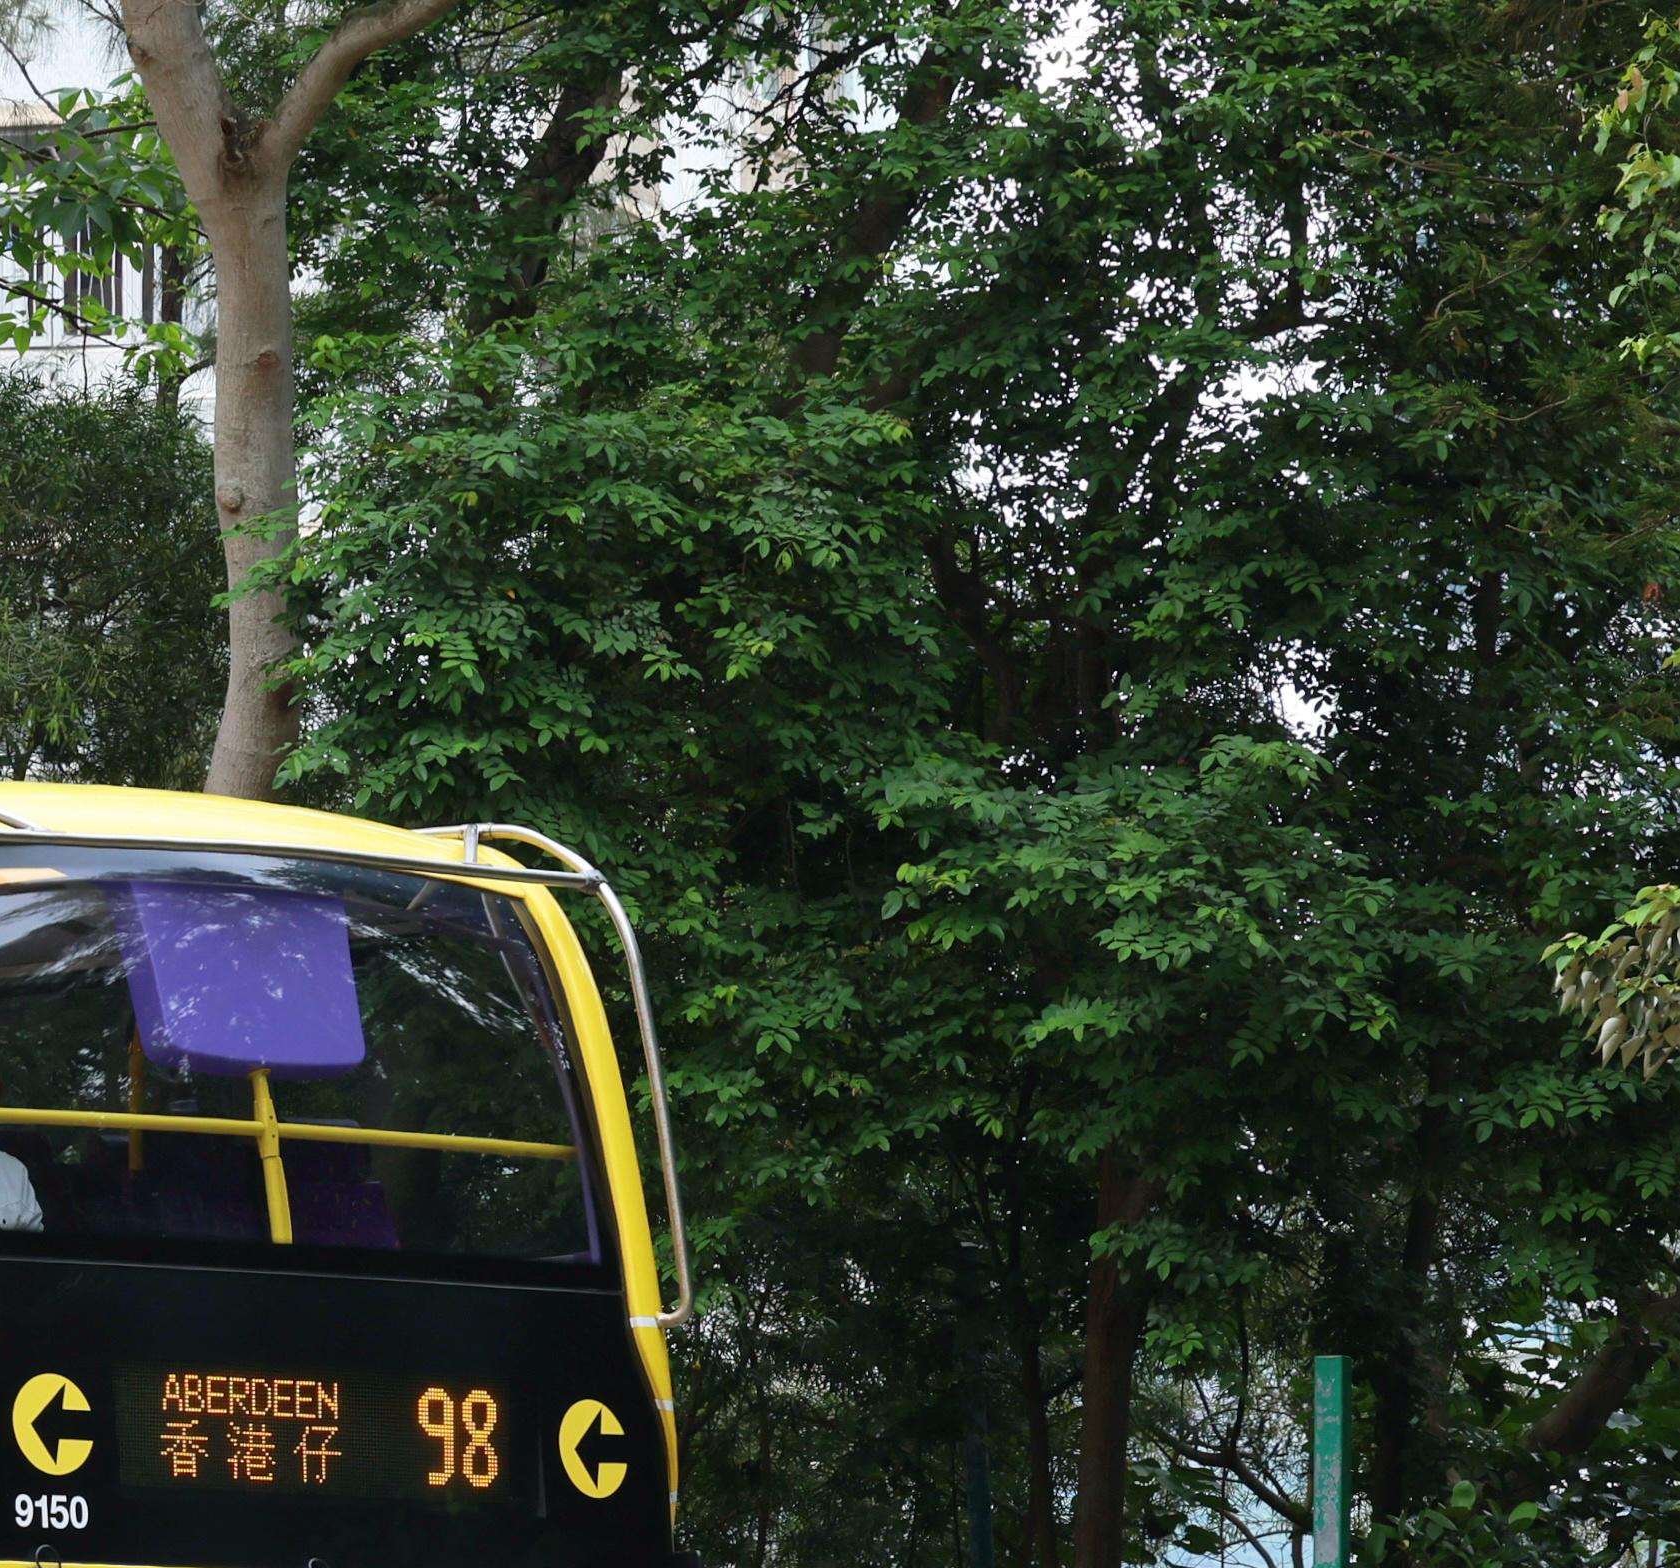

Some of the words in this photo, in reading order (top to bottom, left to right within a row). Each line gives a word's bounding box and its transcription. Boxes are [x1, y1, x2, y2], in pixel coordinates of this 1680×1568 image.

[162, 1373, 339, 1420] ABERDEEN
[160, 1419, 343, 1484] 香港仔
[418, 1387, 499, 1488] 98
[14, 1493, 90, 1530] 9150
